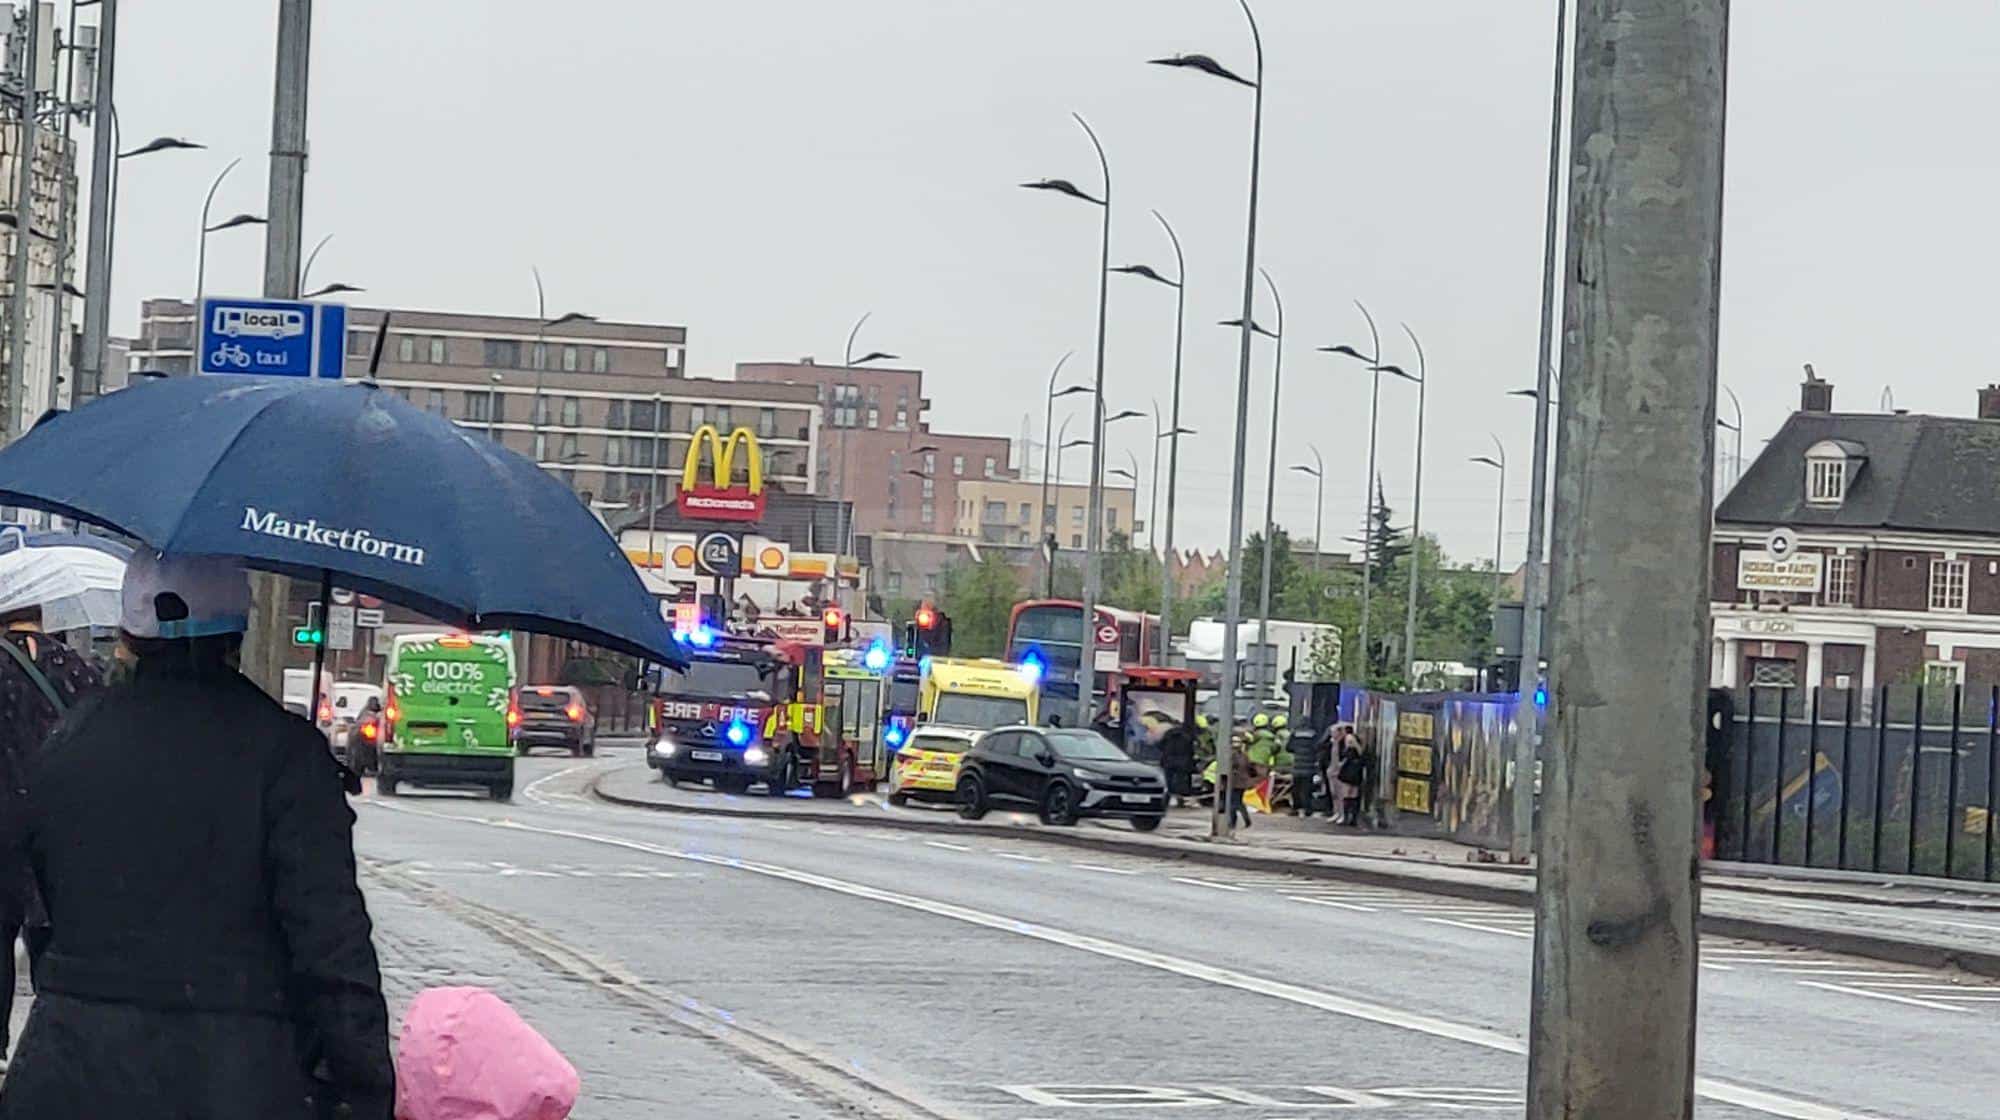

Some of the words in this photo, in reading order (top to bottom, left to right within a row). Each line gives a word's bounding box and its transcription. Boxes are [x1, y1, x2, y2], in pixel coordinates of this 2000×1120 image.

[244, 312, 284, 326] local
[256, 351, 287, 365] taxi
[240, 506, 424, 565] Marketform
[422, 661, 484, 680] 100%
[422, 680, 483, 695] electric
[719, 705, 760, 724] FIRE
[982, 1082, 1525, 1110] BUS
